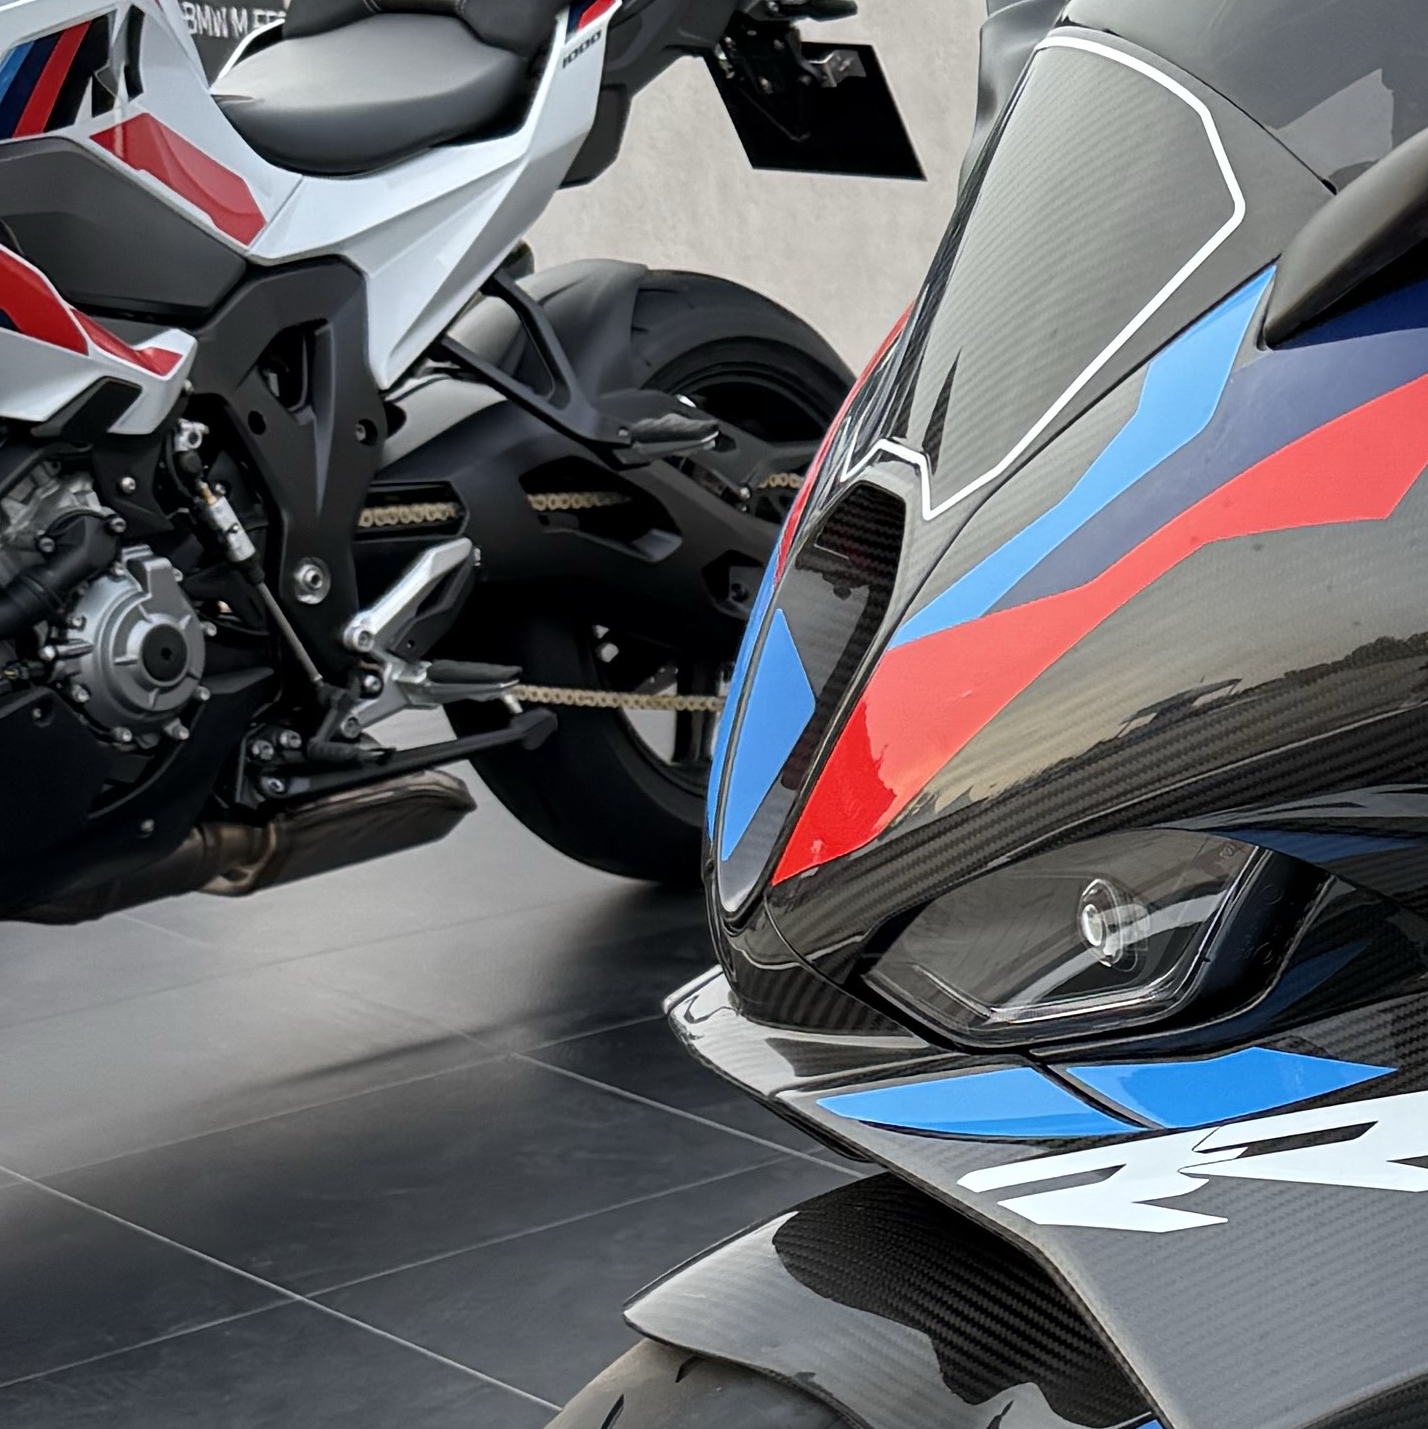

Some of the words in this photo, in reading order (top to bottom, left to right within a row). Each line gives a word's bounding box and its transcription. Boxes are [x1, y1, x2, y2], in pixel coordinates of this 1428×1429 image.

[181, 1, 228, 39] BMW
[230, 6, 249, 38] M
[562, 30, 602, 69] 1000
